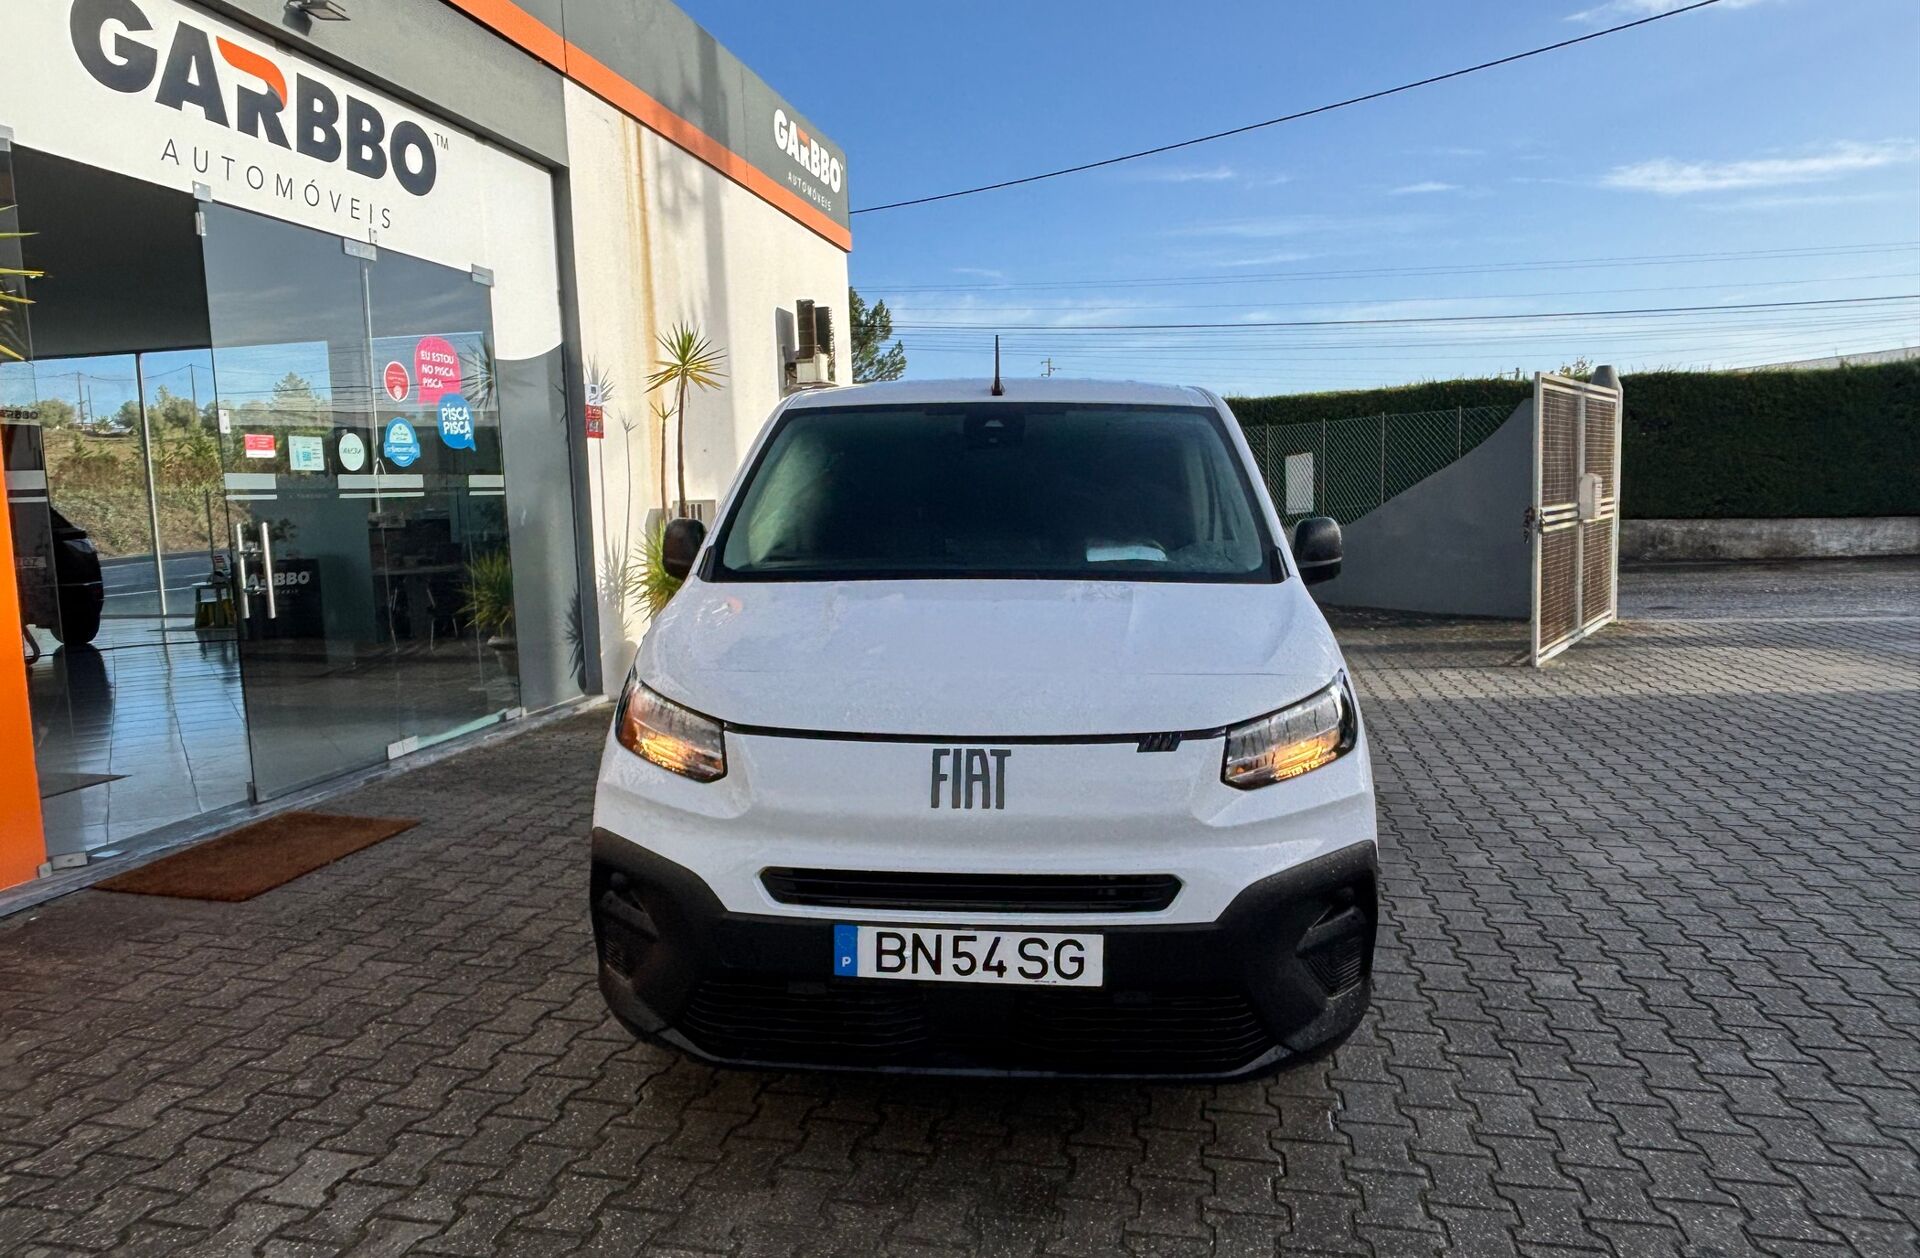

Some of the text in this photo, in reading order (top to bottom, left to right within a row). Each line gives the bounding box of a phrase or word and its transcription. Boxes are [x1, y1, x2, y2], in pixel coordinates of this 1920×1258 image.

[70, 0, 437, 197] GARBBO
[774, 109, 841, 193] GARBBO
[160, 138, 391, 229] AUTOMÓVEIS
[420, 350, 455, 365] EU ESTOU
[421, 363, 455, 377] NO PISCA
[422, 377, 444, 389] PISCA
[443, 421, 471, 435] PISCA
[931, 748, 1012, 810] FIAT
[841, 956, 852, 968] P
